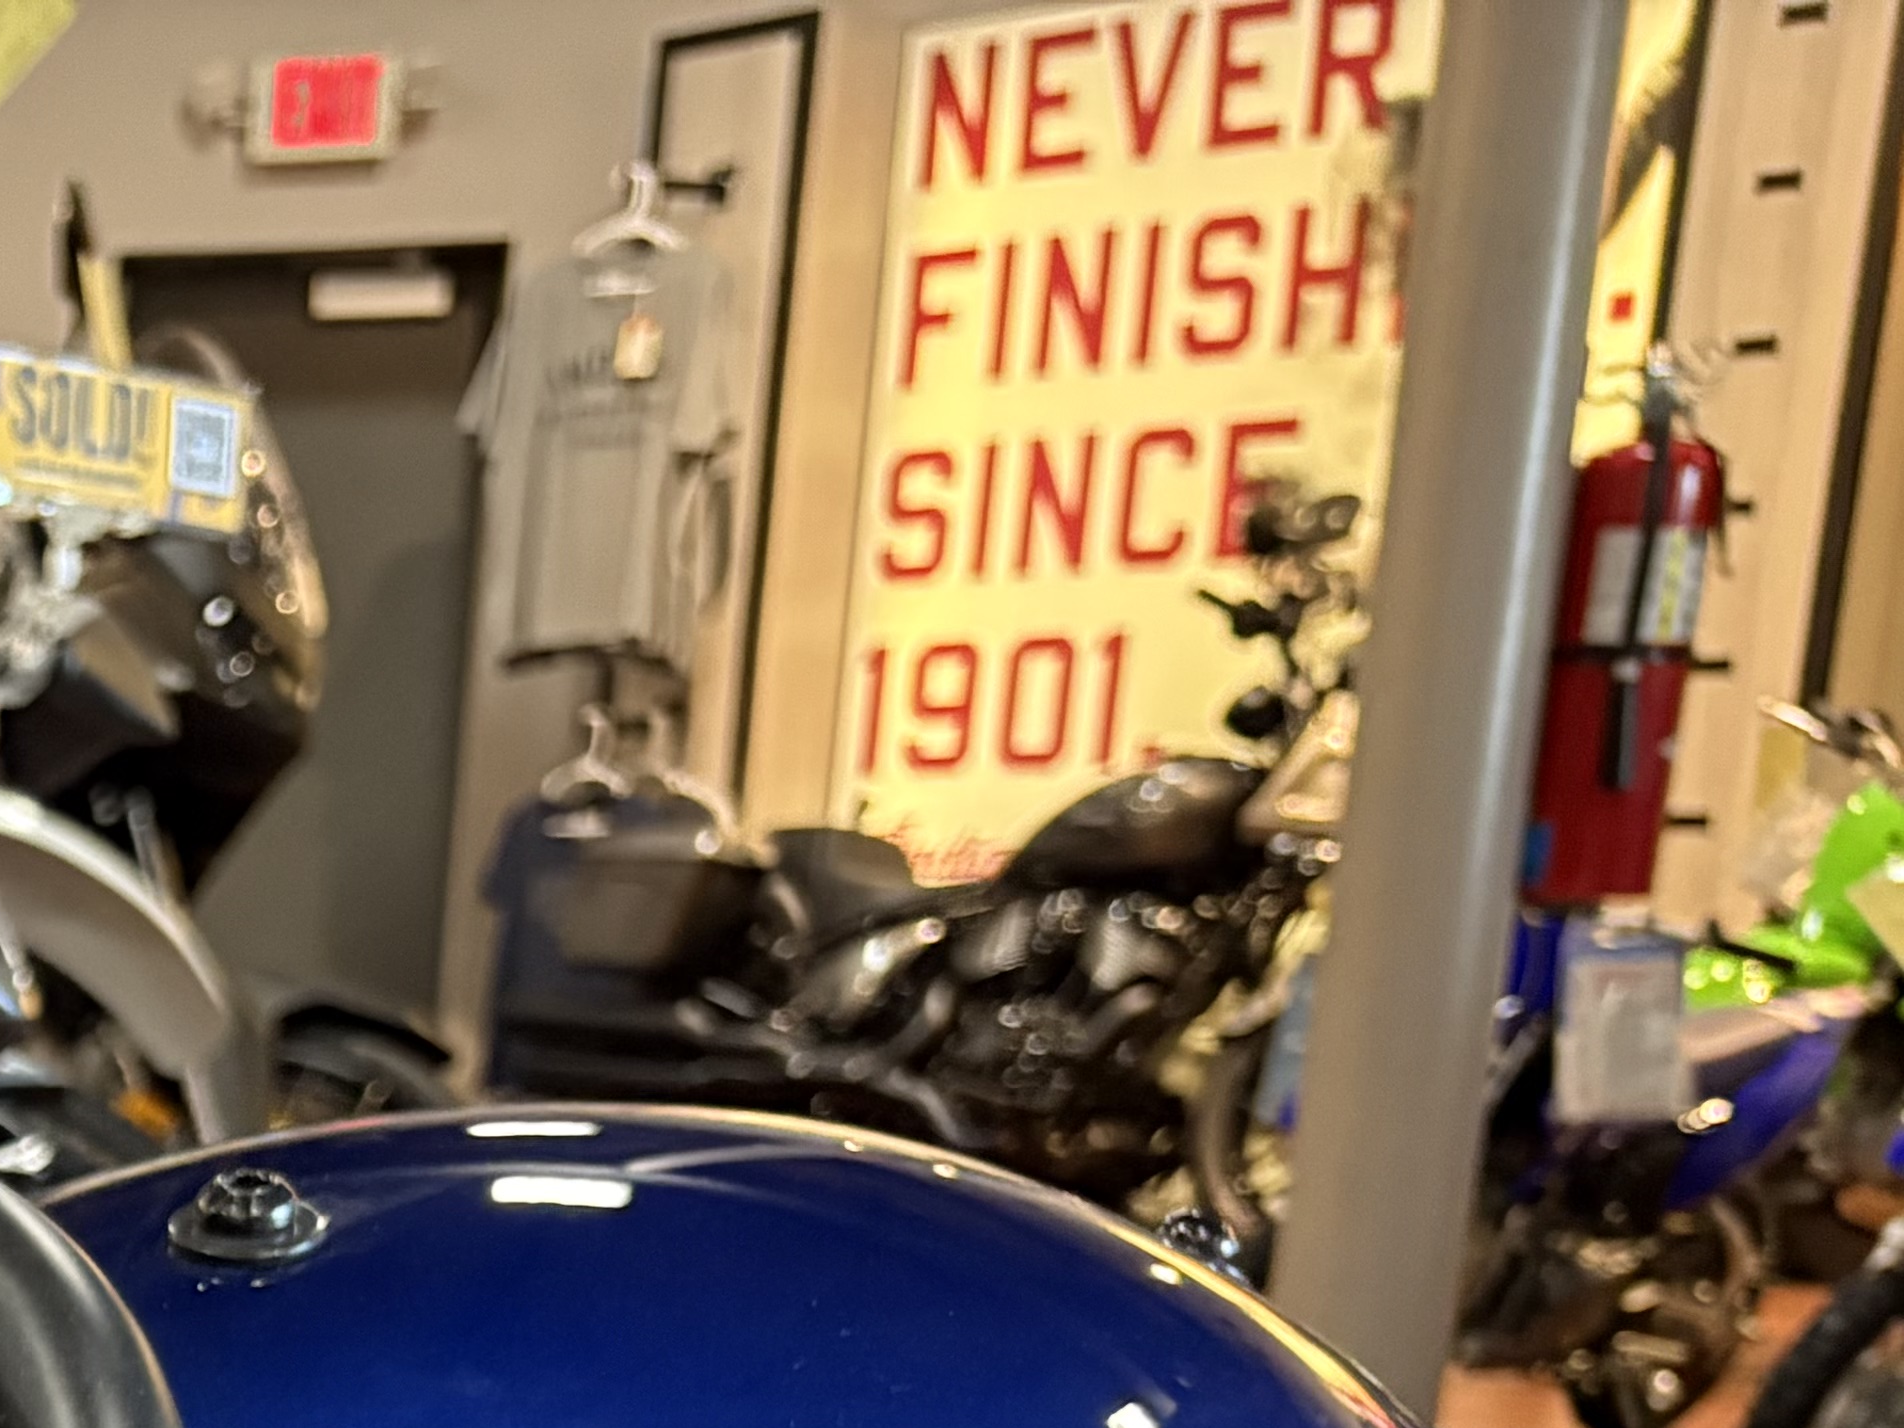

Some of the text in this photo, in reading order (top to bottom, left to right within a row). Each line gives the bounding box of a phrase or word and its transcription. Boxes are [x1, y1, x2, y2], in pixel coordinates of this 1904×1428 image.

[919, 0, 1398, 189] NEVER
[901, 196, 1404, 390] FINISH
[880, 418, 1300, 580] SINCE
